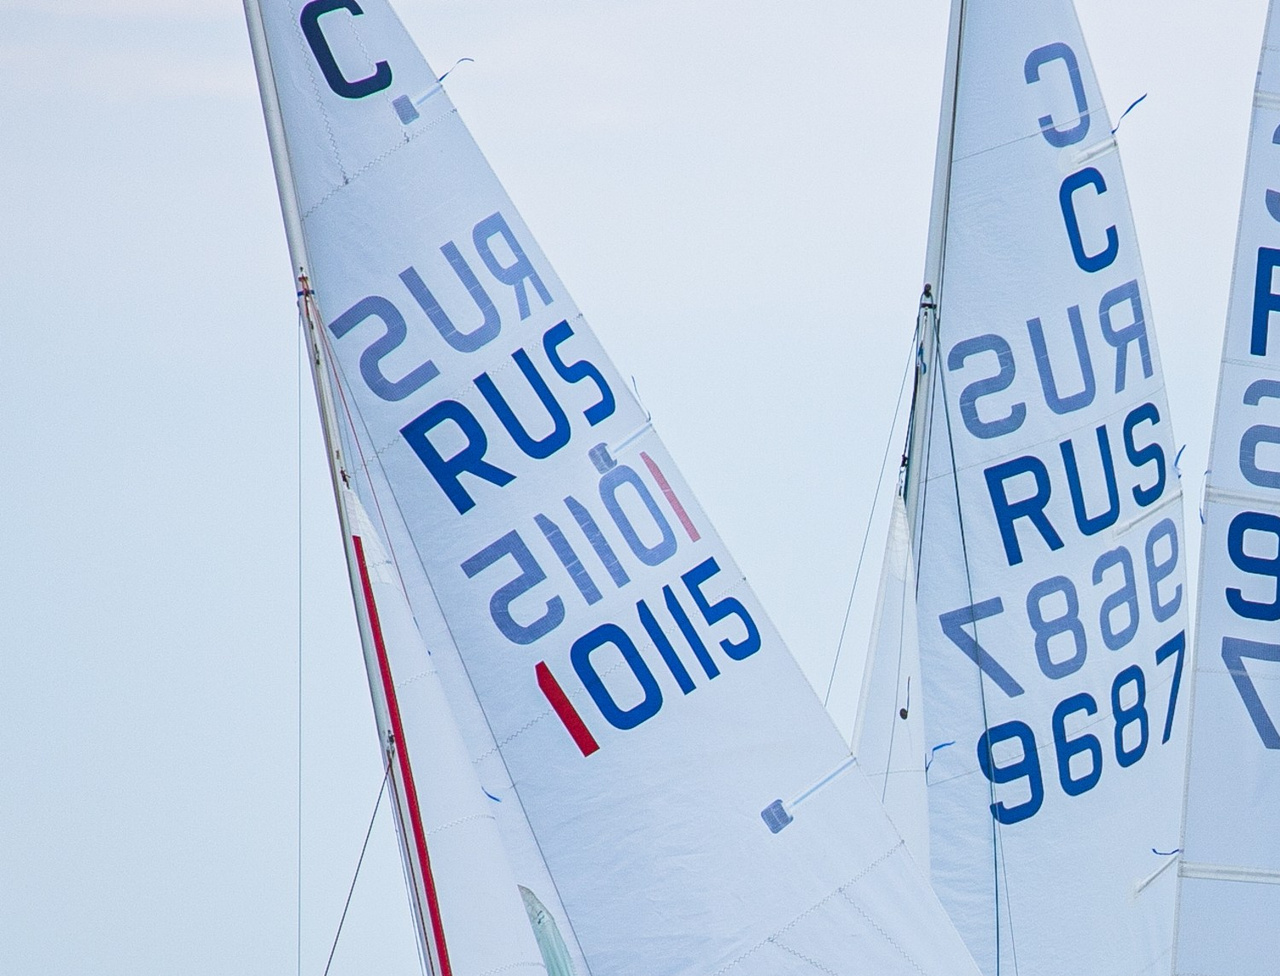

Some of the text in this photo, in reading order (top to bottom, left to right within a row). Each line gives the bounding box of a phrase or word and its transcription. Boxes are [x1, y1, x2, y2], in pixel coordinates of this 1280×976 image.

[299, 0, 393, 99] C
[1059, 167, 1120, 273] C
[399, 319, 617, 516] RUS
[983, 402, 1167, 567] RUS
[535, 556, 762, 758] 10115
[976, 629, 1187, 825] 9687
